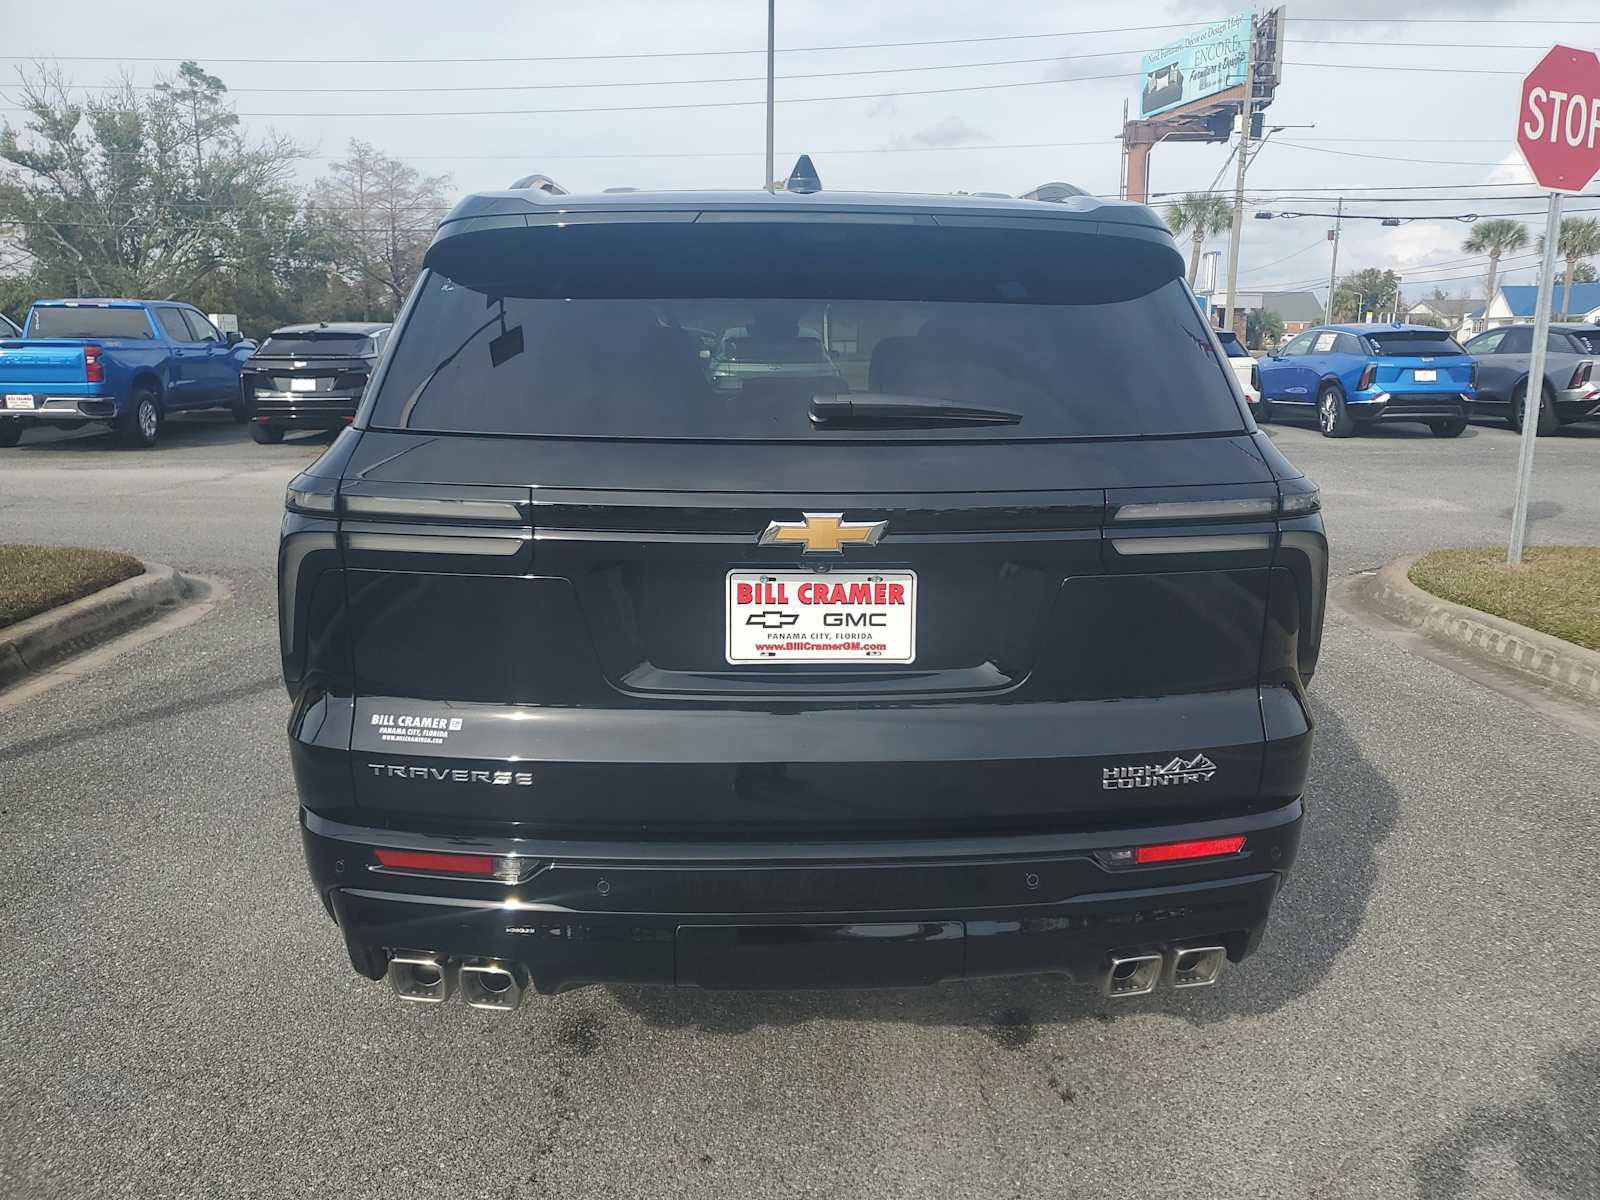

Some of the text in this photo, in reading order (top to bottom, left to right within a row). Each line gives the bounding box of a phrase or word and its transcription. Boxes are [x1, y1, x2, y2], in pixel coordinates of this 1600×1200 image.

[1194, 34, 1240, 66] ENCORE
[737, 583, 905, 605] BILL CRAMER
[823, 613, 887, 627] GMC
[767, 632, 873, 641] PANAMA CITY, FLORIDA
[756, 642, 887, 651] www.BillCramerGM.com
[371, 714, 394, 726] BILL
[398, 715, 447, 729] CRAMER
[379, 727, 406, 735] PANAMA
[422, 730, 448, 738] FLORIDA
[368, 763, 533, 786] TRAVERSE
[1103, 765, 1215, 789] HIGH COUNTRY
